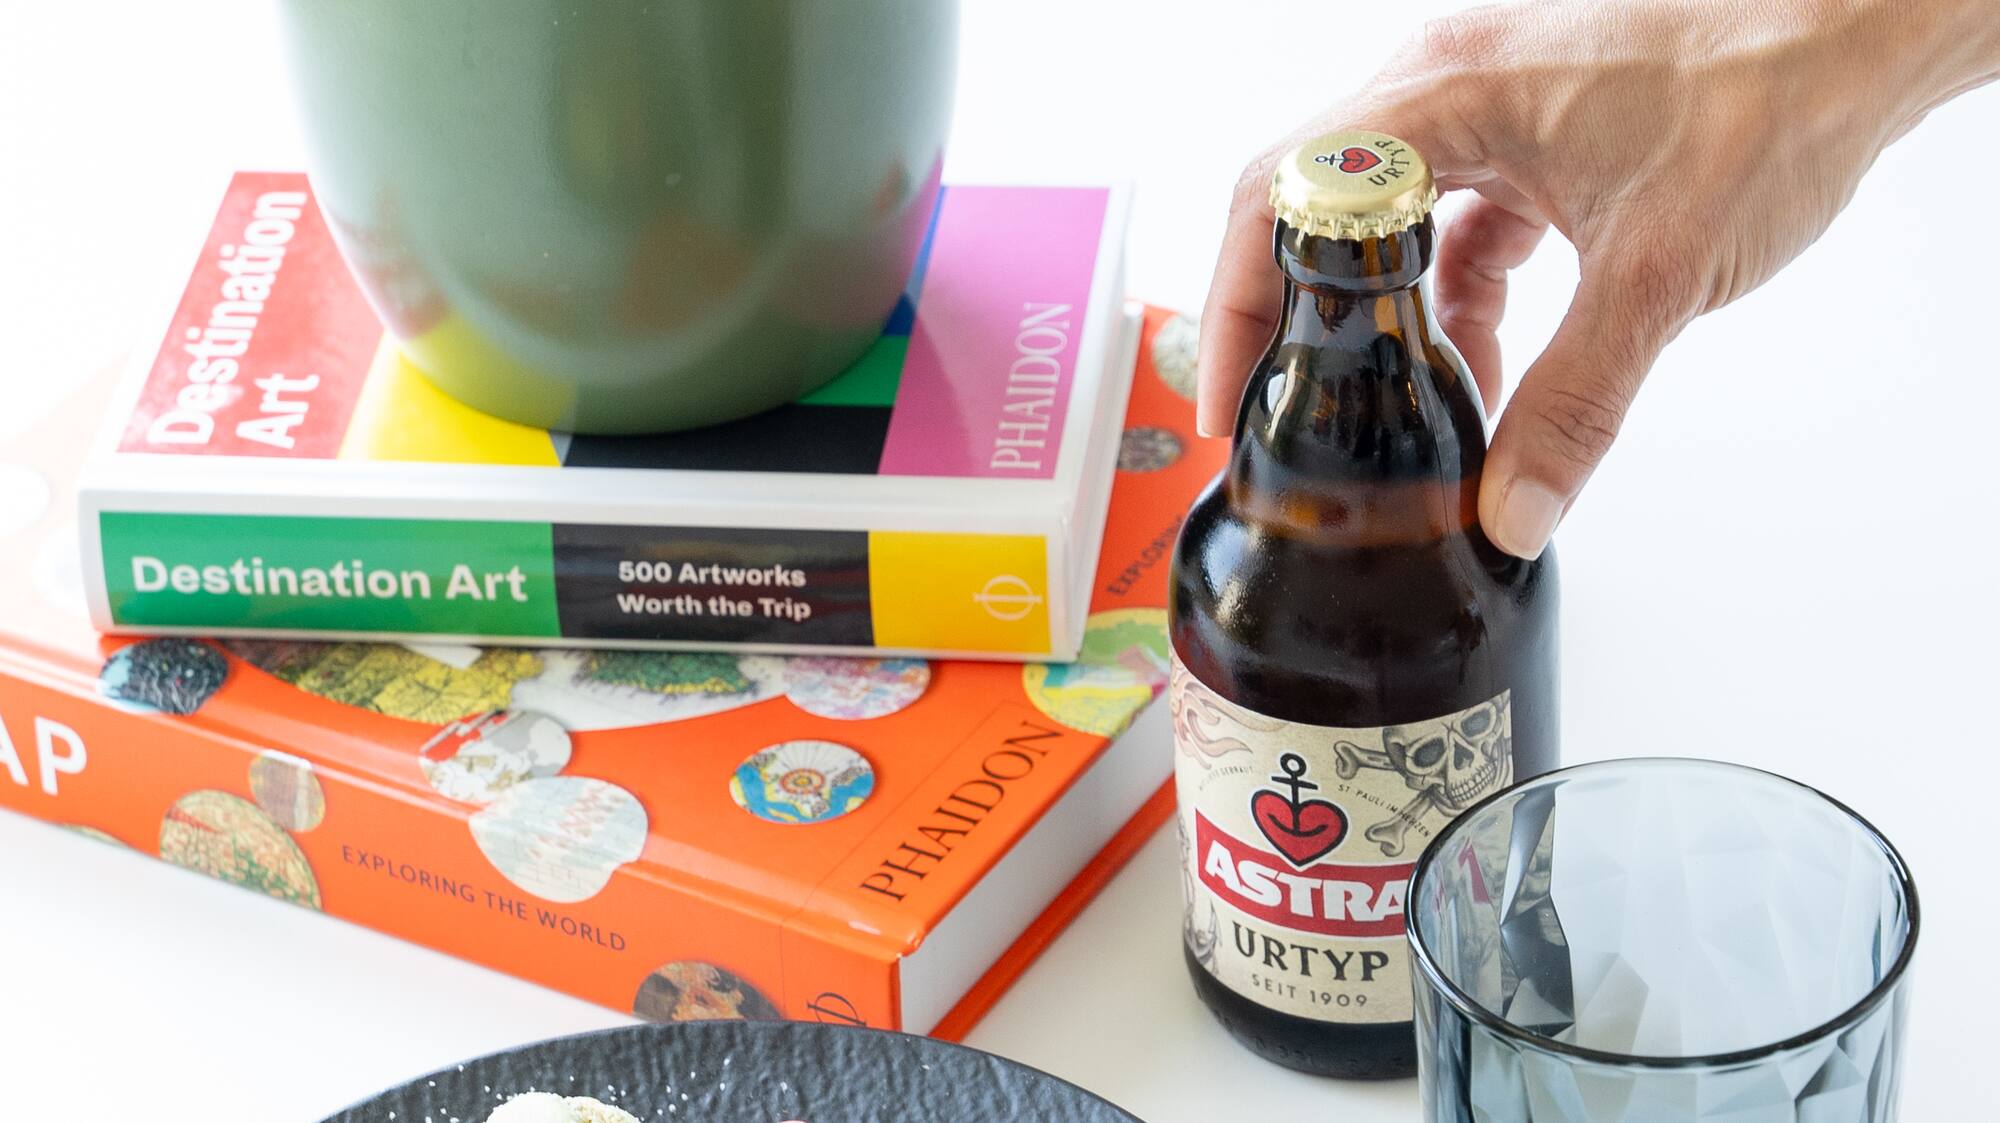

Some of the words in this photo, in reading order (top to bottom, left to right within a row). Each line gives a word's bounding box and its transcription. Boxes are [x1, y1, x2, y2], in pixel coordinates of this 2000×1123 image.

[1368, 140, 1410, 187] URTYP
[148, 190, 308, 445] Destination
[235, 372, 320, 450] Art
[990, 302, 1074, 471] PHAIDON
[131, 556, 432, 599] Destination
[445, 564, 529, 602] Art
[618, 560, 673, 584] 500
[678, 562, 807, 588] Artworks
[616, 593, 704, 616] Worth
[708, 595, 754, 617] the
[758, 597, 812, 622] Trip
[860, 720, 1065, 902] PHAIDON
[1356, 789, 1385, 808] PAULI
[1400, 809, 1431, 838] HERZEN
[341, 845, 476, 903] EXPLORING
[484, 890, 529, 921] THE
[536, 907, 627, 952] WORLD
[1204, 844, 1409, 923] ASTRA
[1232, 920, 1389, 982] URTYP
[1251, 974, 1297, 999] SEIT
[1309, 990, 1368, 1008] 1909
